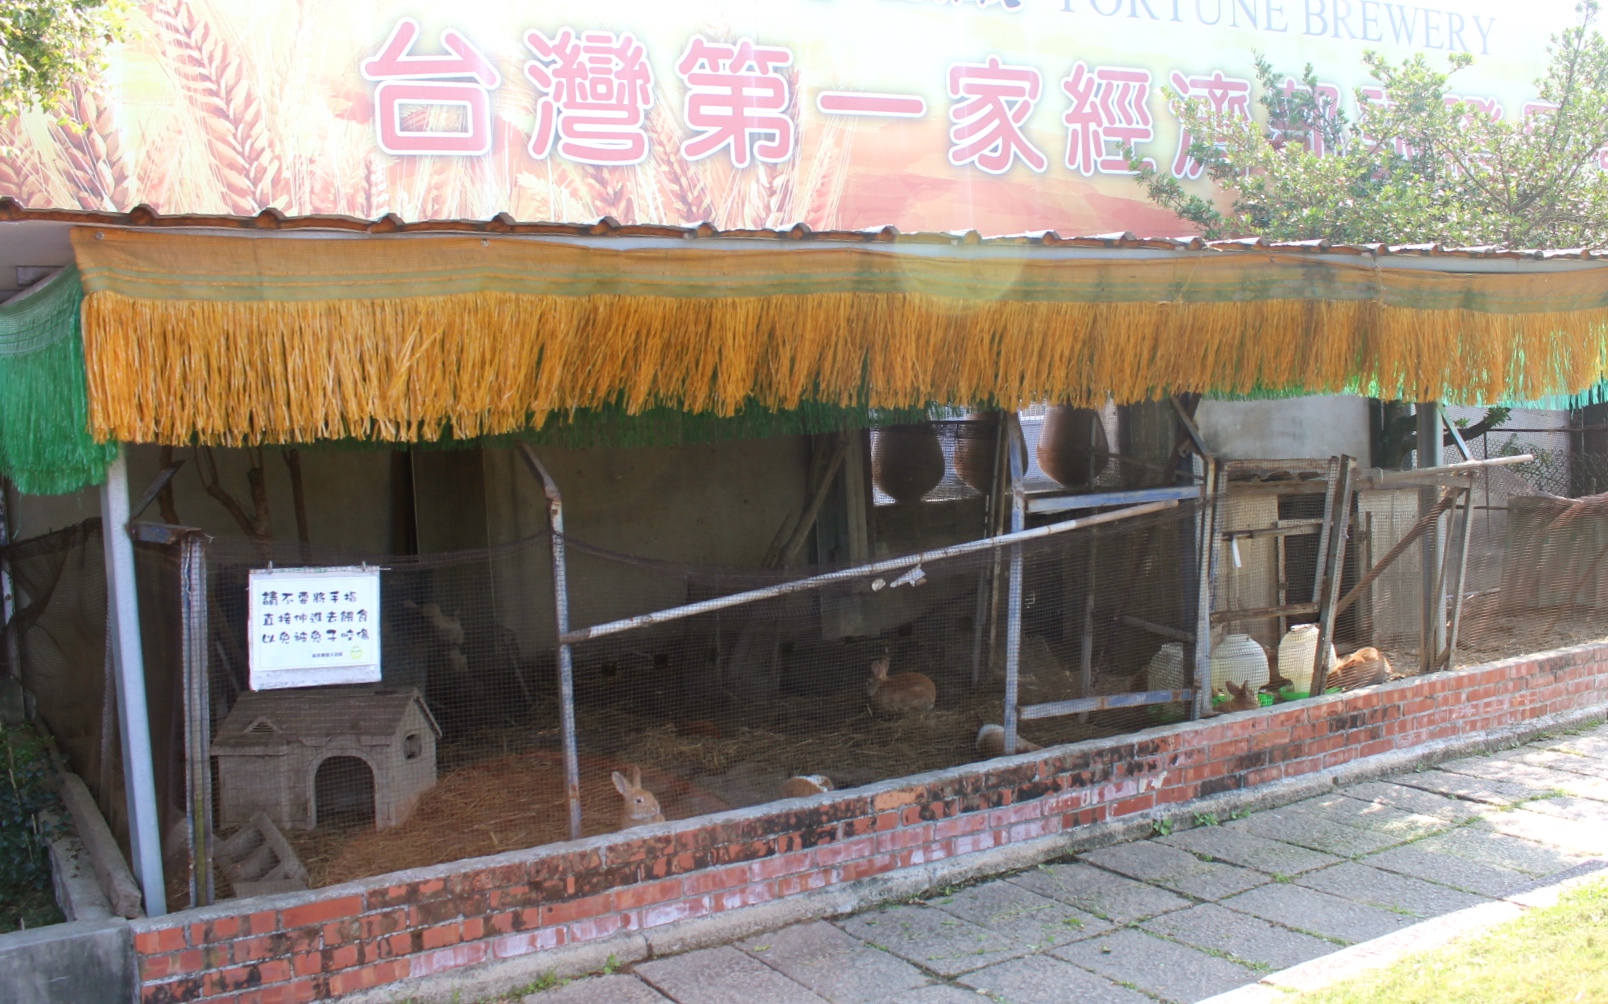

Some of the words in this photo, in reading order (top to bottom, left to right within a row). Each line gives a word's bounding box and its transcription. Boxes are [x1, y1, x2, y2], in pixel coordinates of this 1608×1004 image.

[1302, 0, 1496, 56] BREWERY
[261, 590, 357, 606] 請不要將手指
